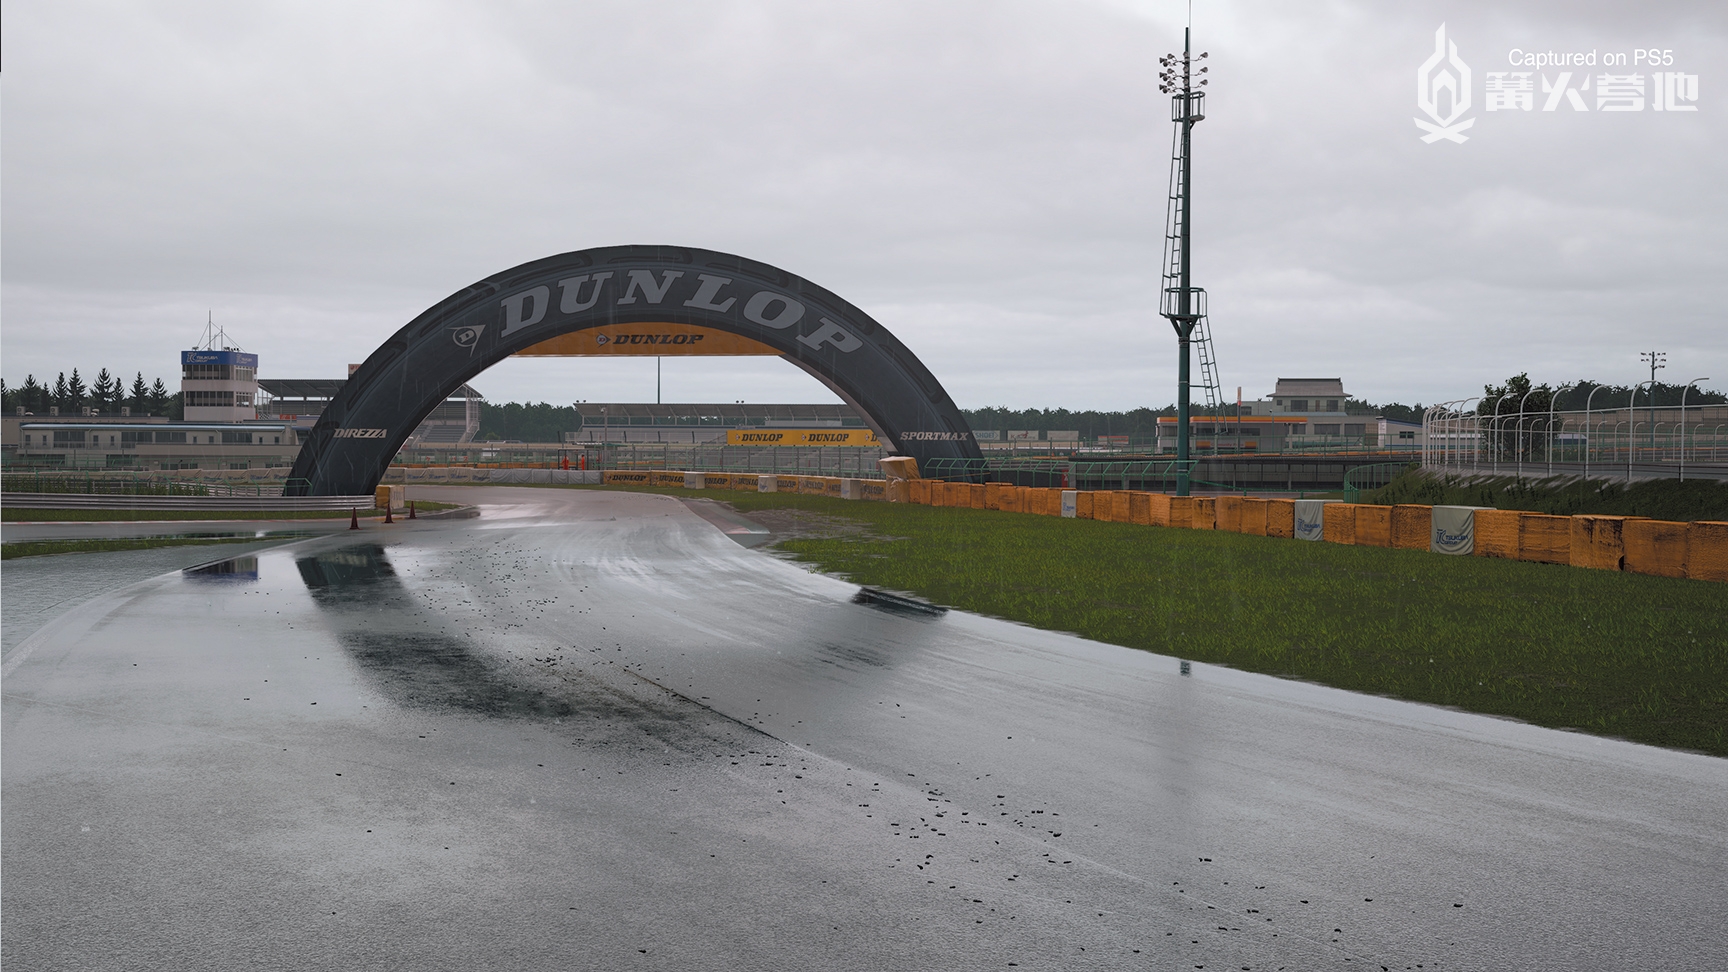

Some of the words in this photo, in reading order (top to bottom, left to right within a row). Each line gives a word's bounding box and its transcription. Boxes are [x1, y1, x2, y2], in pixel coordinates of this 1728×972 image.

[500, 269, 863, 353] DUNLOP
[613, 334, 704, 345] DUNLOP
[333, 428, 388, 439] DIREZZA
[741, 433, 783, 442] DUNLOP
[808, 433, 849, 442] DUNLOP
[900, 431, 969, 441] SPORTMAX
[659, 475, 685, 483] DUNLO
